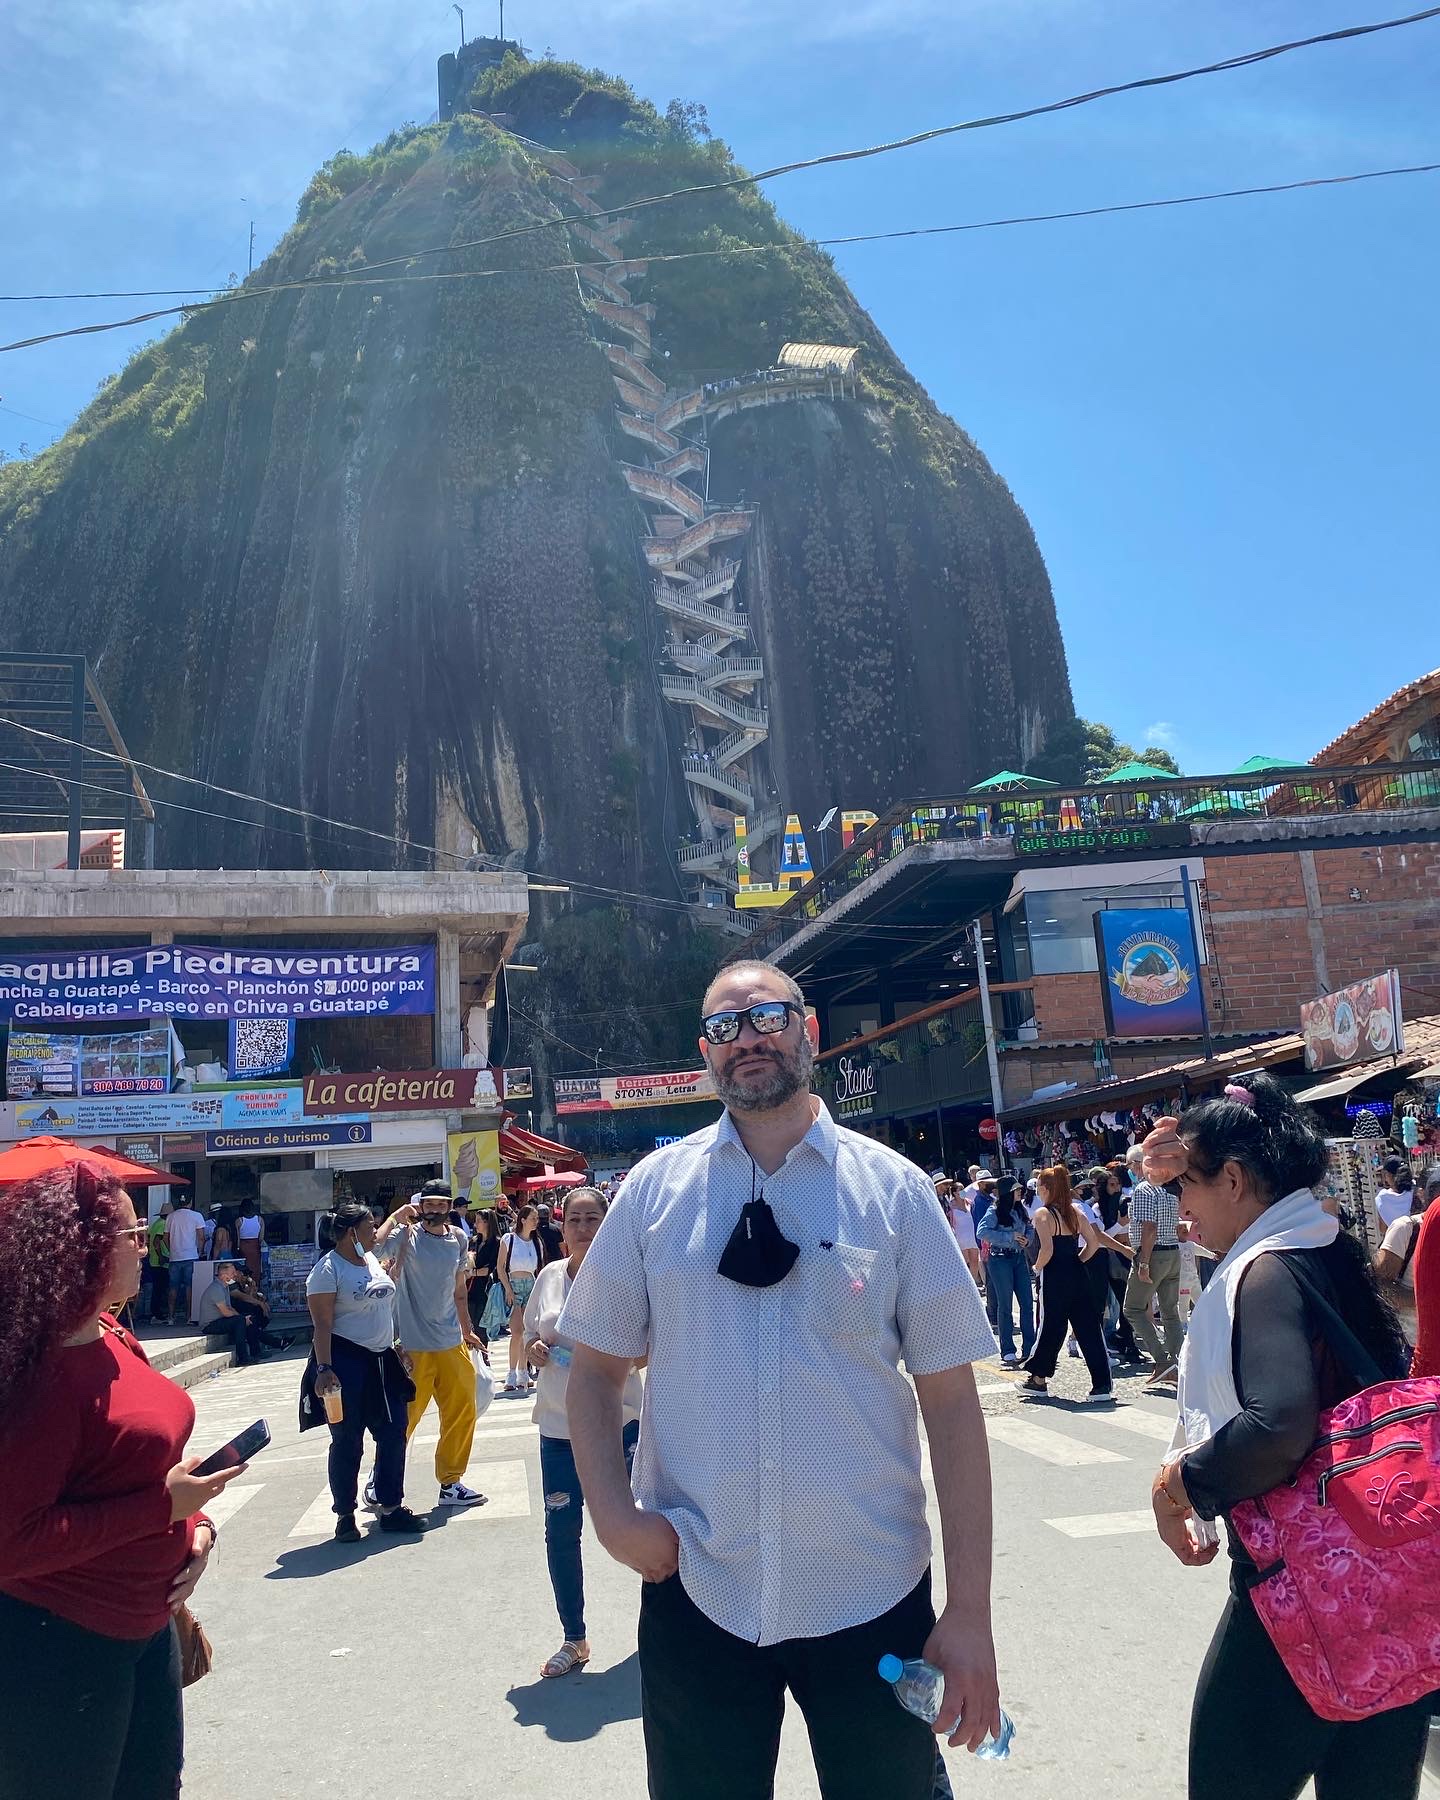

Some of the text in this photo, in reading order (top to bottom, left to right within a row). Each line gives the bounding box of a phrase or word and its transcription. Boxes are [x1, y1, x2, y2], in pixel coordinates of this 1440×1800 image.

[1020, 838, 1048, 851] QUE
[1052, 835, 1095, 848] USTED
[1100, 834, 1107, 845] Y
[145, 950, 420, 975] Piedraventura
[48, 989, 59, 998] a
[64, 980, 140, 999] Guatapé
[158, 979, 210, 995] Barco
[227, 980, 309, 995] Planchón
[372, 981, 395, 995] por
[399, 979, 424, 994] pax
[14, 1001, 118, 1019] Cabalgata
[138, 998, 199, 1014] Paseo
[205, 1003, 228, 1014] en
[234, 999, 288, 1014] Chiva
[293, 1004, 304, 1014] a
[310, 996, 389, 1014] Guatapé
[93, 1078, 163, 1093] 304 489 79 20
[621, 1078, 663, 1088] Terraza
[836, 1057, 874, 1100] Stone
[306, 1072, 455, 1109] La cafetería
[615, 1087, 653, 1099] STONE
[666, 1085, 697, 1095] Letras
[215, 1133, 260, 1147] Oficina
[264, 1131, 279, 1144] de
[284, 1131, 330, 1144] turismo
